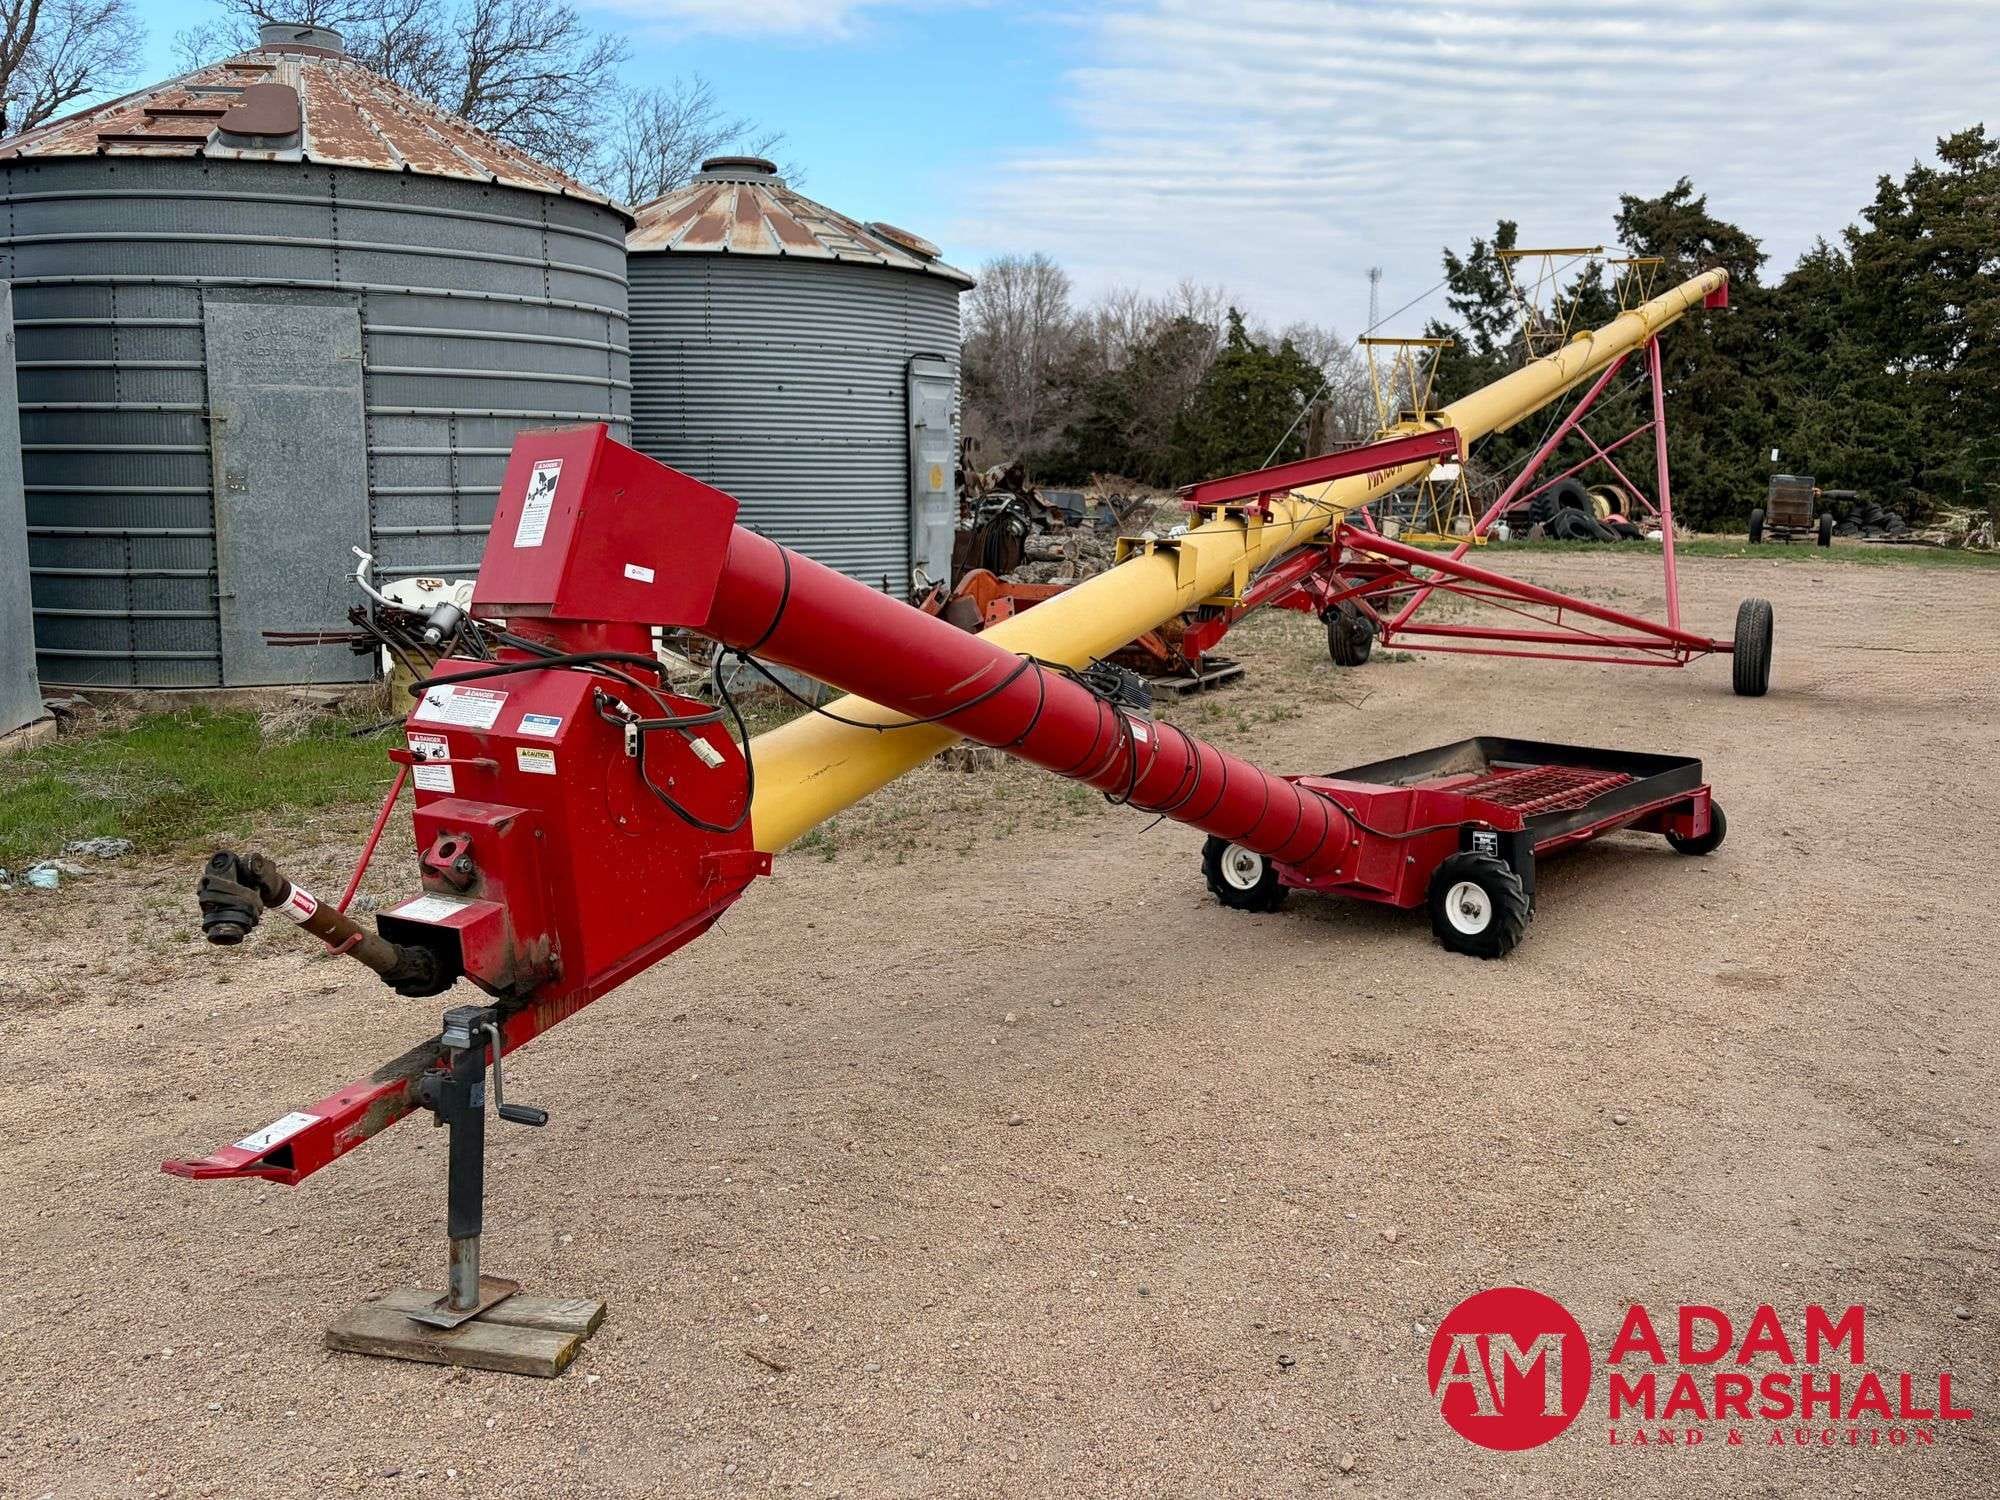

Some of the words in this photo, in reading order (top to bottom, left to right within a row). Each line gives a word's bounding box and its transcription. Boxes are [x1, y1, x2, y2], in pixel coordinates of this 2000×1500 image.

[470, 691, 495, 699] DANGER
[419, 735, 442, 743] DANGER
[526, 751, 550, 759] CAUTION
